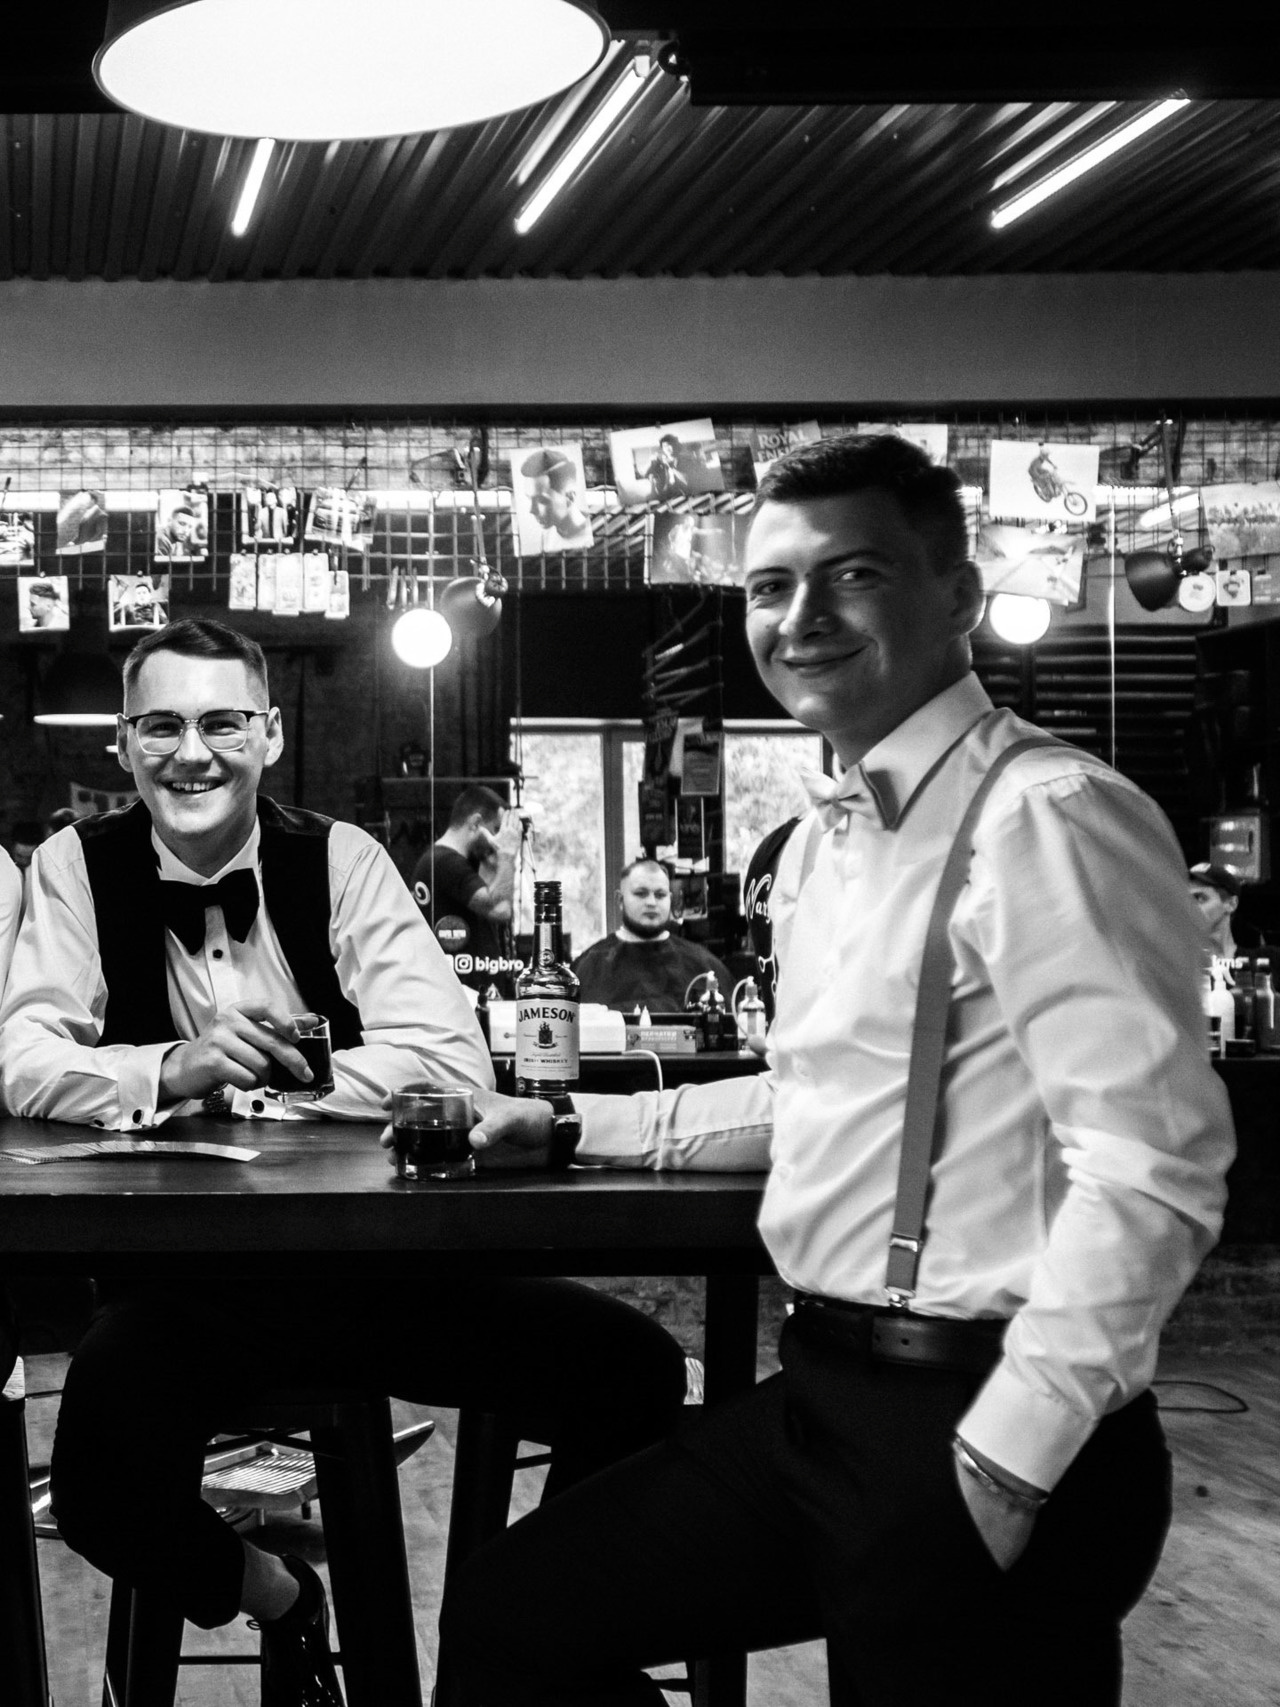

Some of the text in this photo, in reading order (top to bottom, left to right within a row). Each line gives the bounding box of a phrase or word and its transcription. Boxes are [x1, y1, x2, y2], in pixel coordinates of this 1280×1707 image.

[758, 428, 809, 449] ROYAL
[475, 956, 524, 975] bigbro
[518, 1006, 575, 1024] JAMESON
